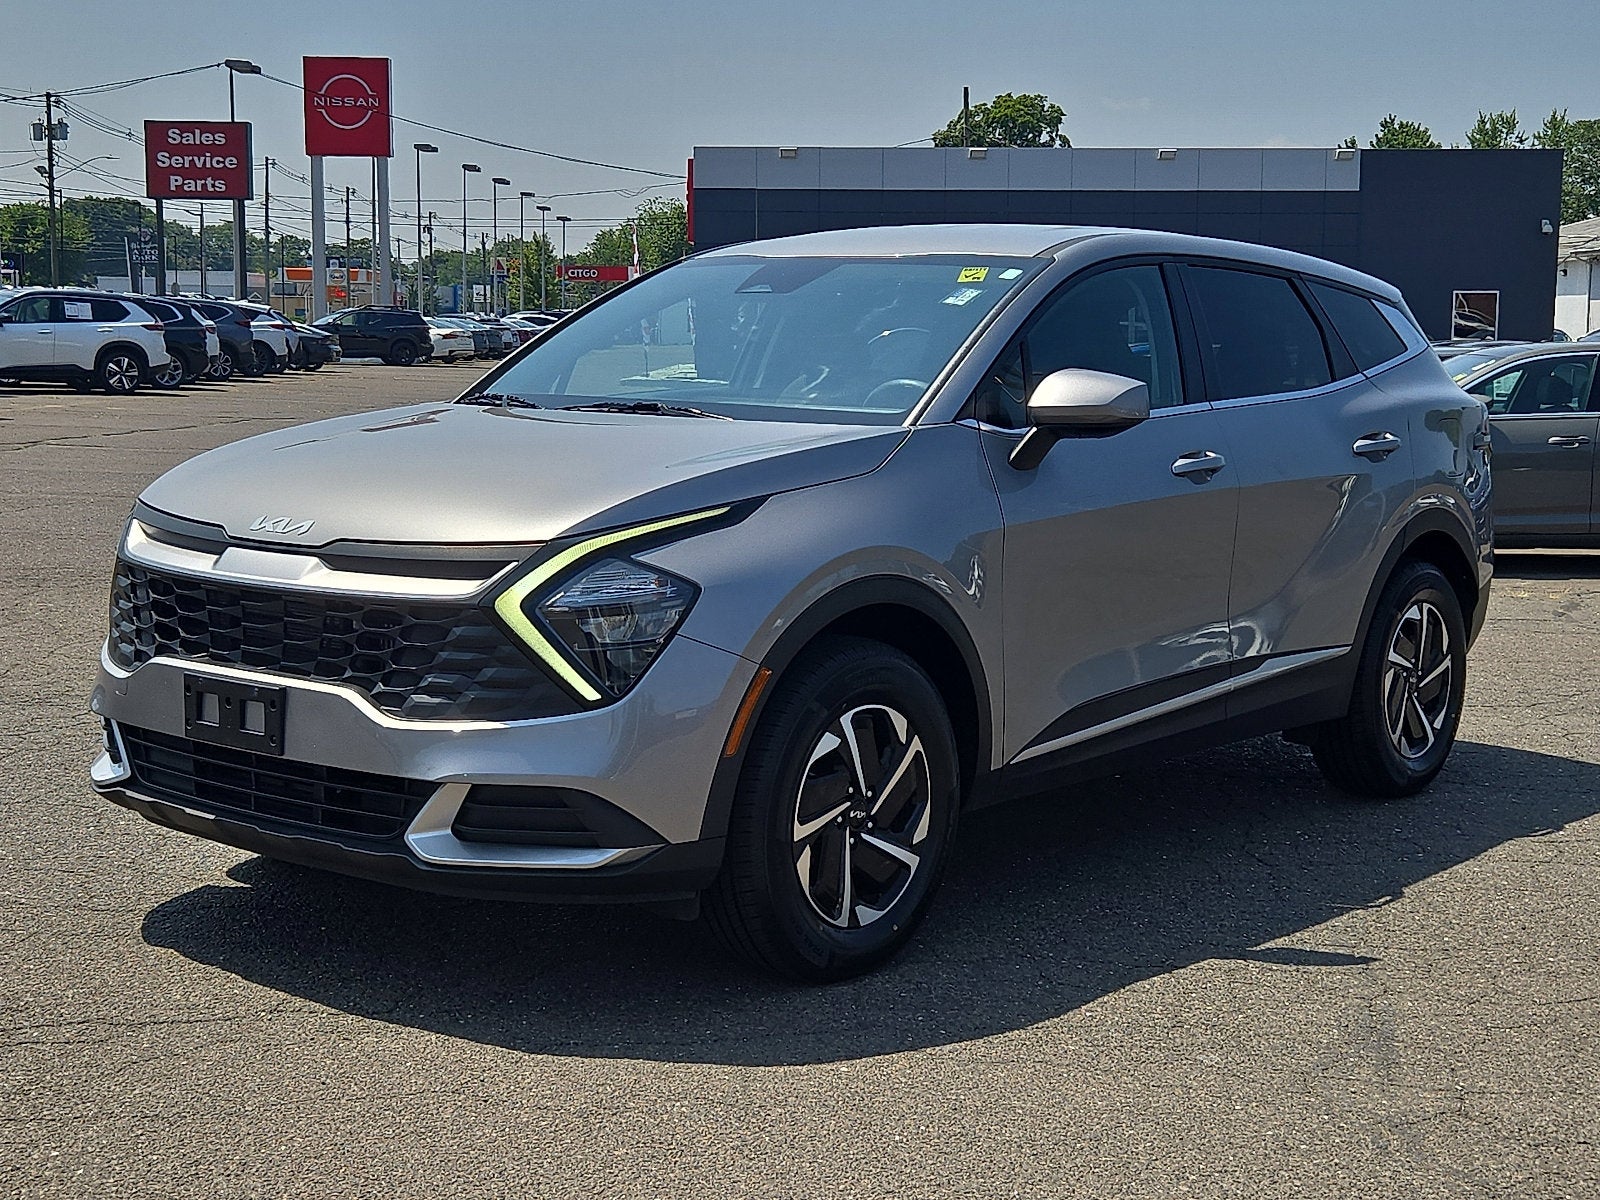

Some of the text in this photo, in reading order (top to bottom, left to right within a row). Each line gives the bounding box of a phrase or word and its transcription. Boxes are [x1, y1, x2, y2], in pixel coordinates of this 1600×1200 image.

[314, 96, 379, 107] NISSAN
[167, 128, 226, 145] Sales
[156, 151, 238, 169] Service
[169, 175, 227, 192] Parts
[568, 269, 598, 278] CITGO
[249, 515, 316, 536] KIA
